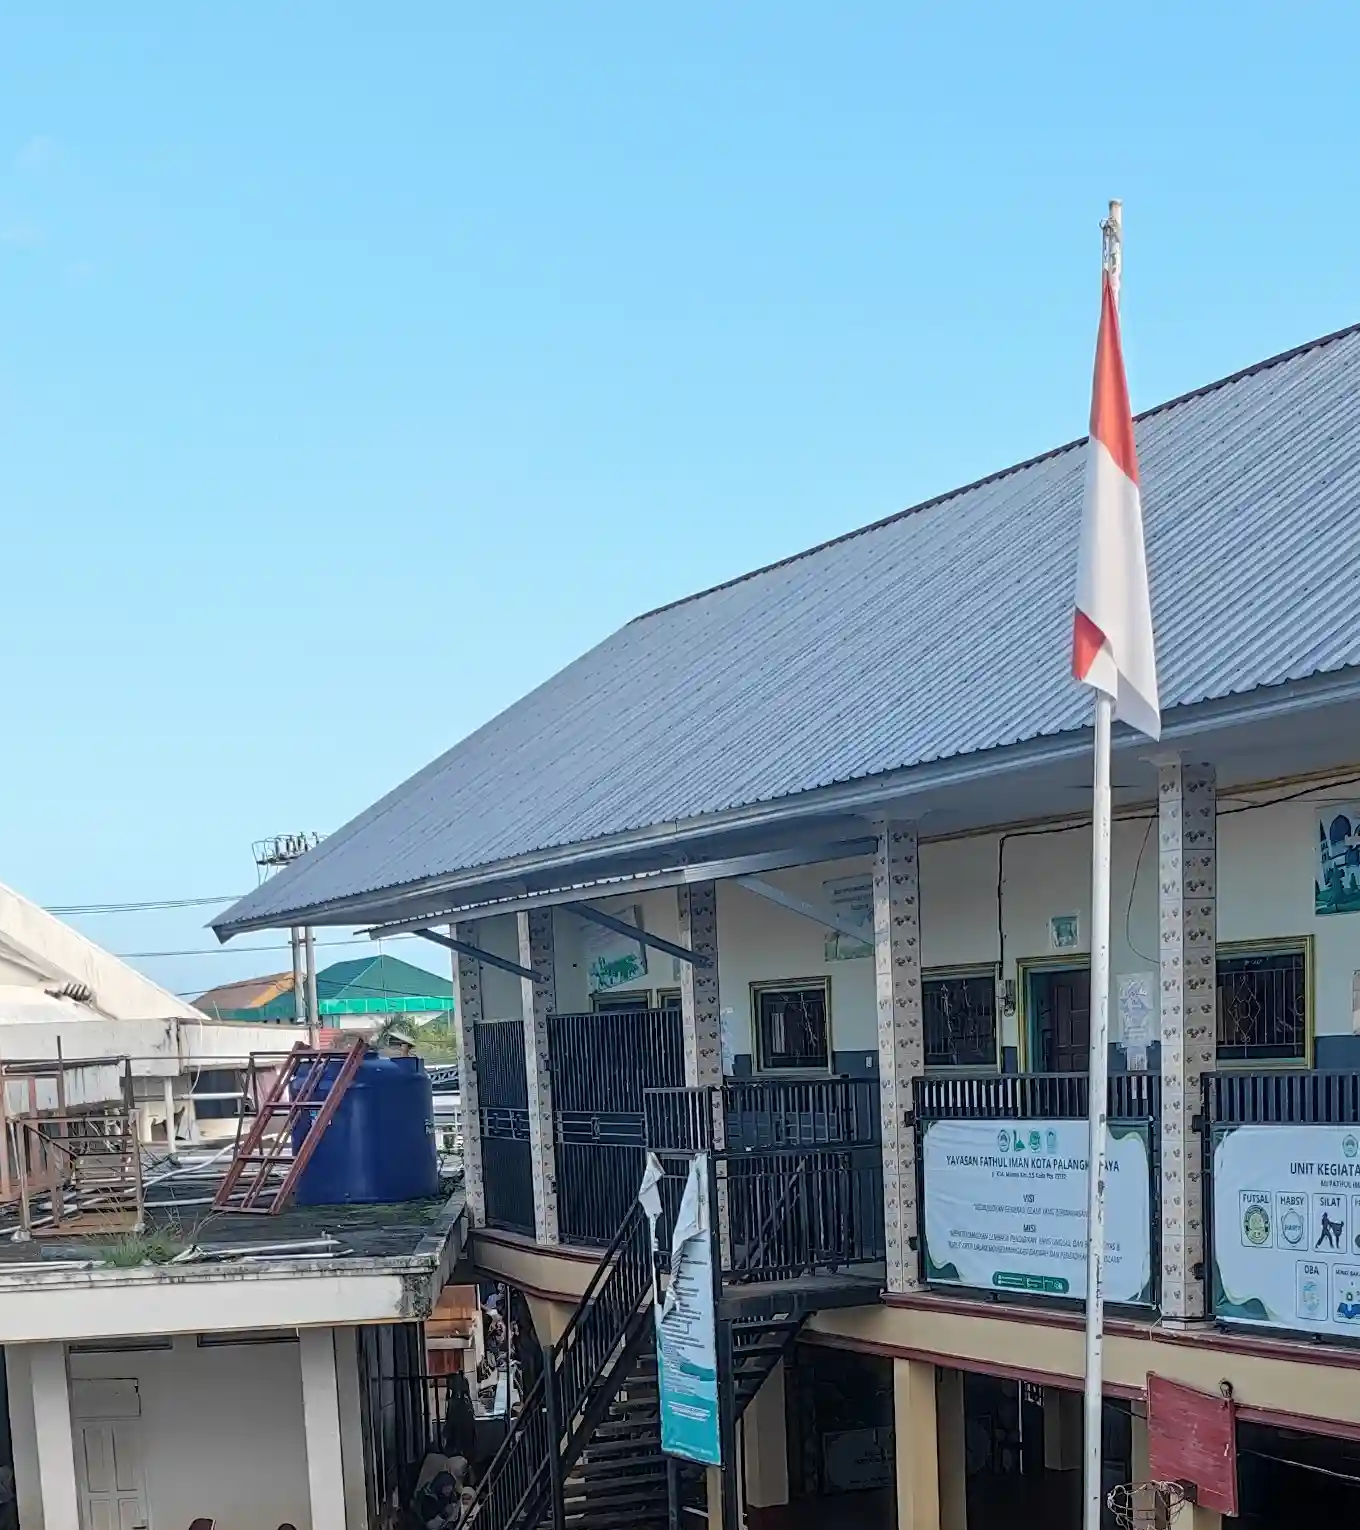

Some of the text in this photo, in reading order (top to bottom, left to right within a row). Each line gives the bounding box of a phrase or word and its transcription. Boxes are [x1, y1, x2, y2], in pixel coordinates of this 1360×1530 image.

[946, 1155, 979, 1167] YAYASAN
[980, 1156, 1008, 1168] FATHUL
[1009, 1157, 1029, 1169] IMAN
[1031, 1157, 1052, 1170] KOTA
[1053, 1158, 1089, 1171] PALANGK
[1290, 1162, 1314, 1175] UNIT
[1242, 1193, 1270, 1204] FUTSAL
[1320, 1197, 1341, 1207] SILAT
